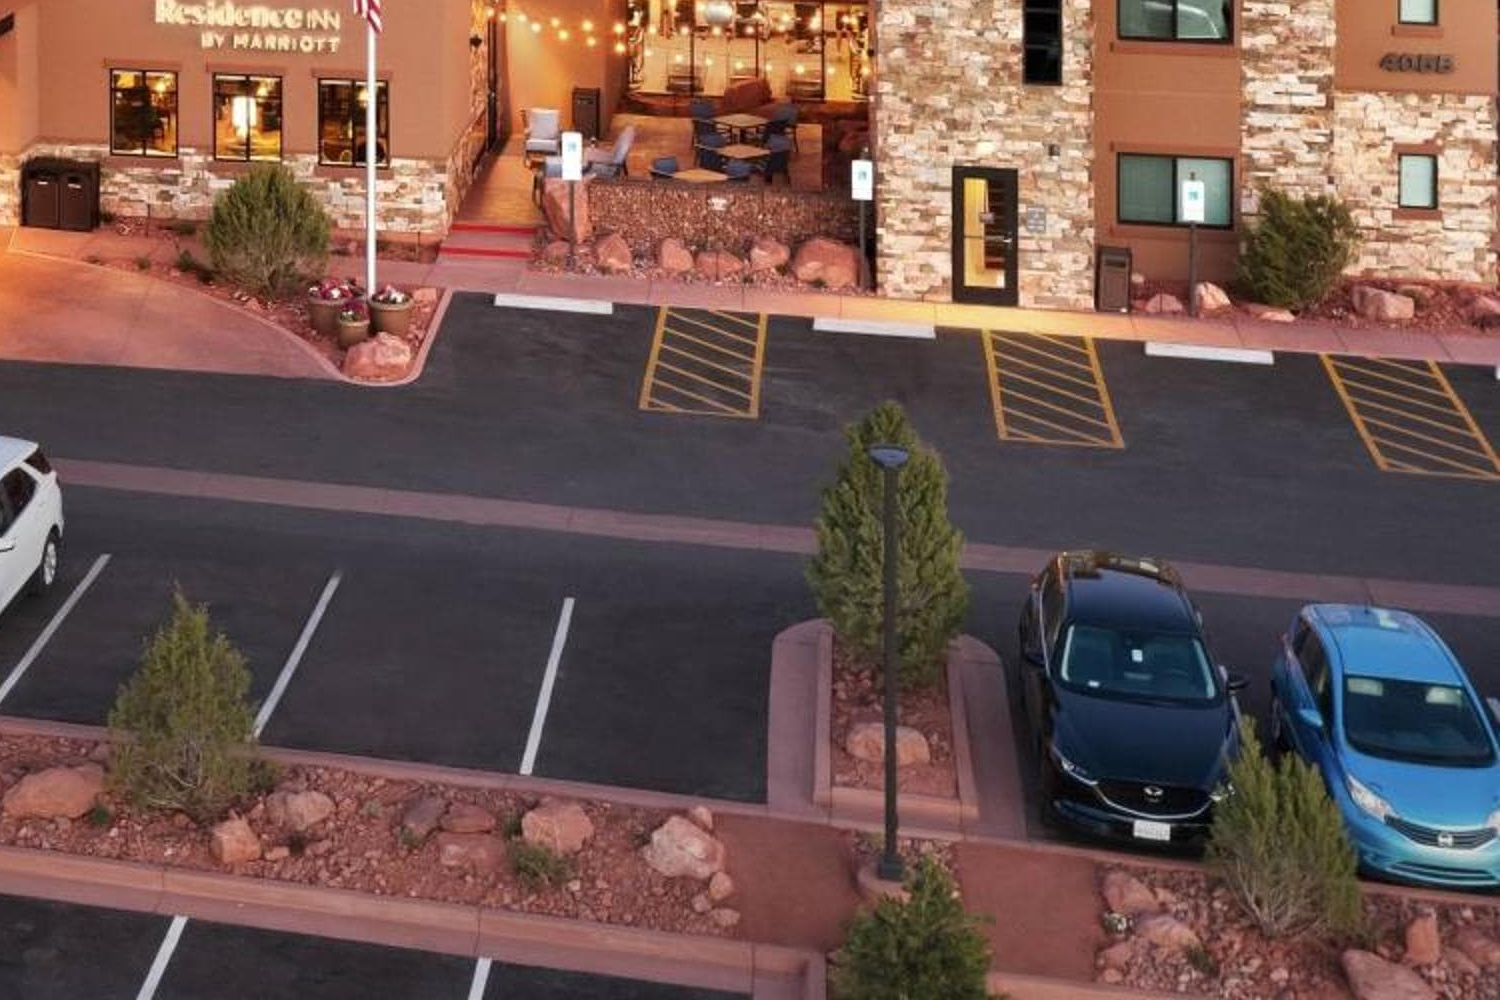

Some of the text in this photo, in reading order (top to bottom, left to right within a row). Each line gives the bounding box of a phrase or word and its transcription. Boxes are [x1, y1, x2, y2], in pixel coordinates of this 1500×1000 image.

[306, 8, 341, 30] INN
[201, 31, 341, 53] BY MARRIOTT
